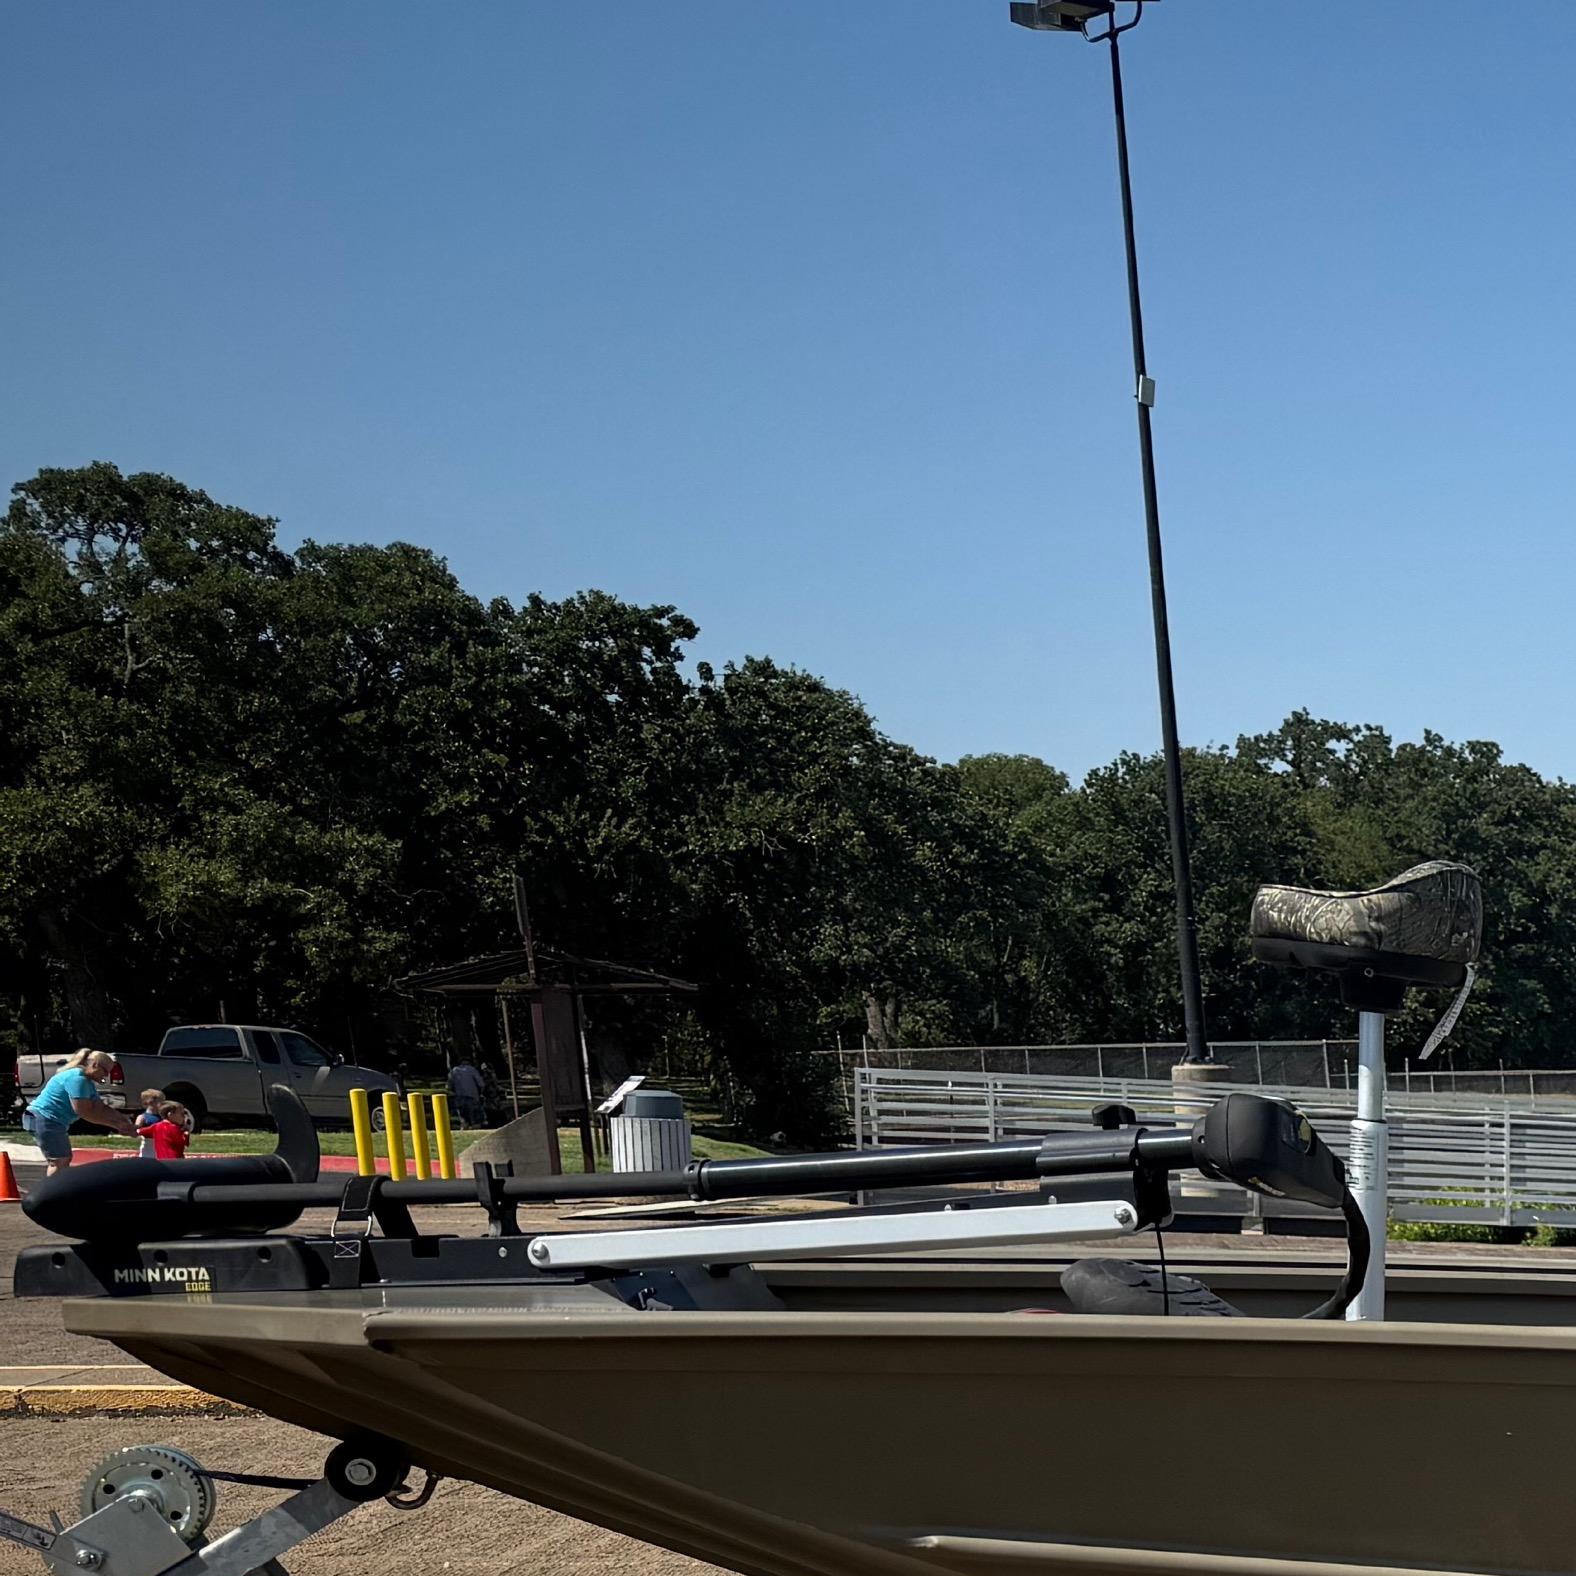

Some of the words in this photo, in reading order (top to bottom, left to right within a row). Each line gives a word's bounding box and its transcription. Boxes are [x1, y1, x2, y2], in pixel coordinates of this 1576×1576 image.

[114, 1267, 160, 1283] MINN
[164, 1266, 210, 1282] KOTA
[185, 1281, 212, 1292] EDGE
